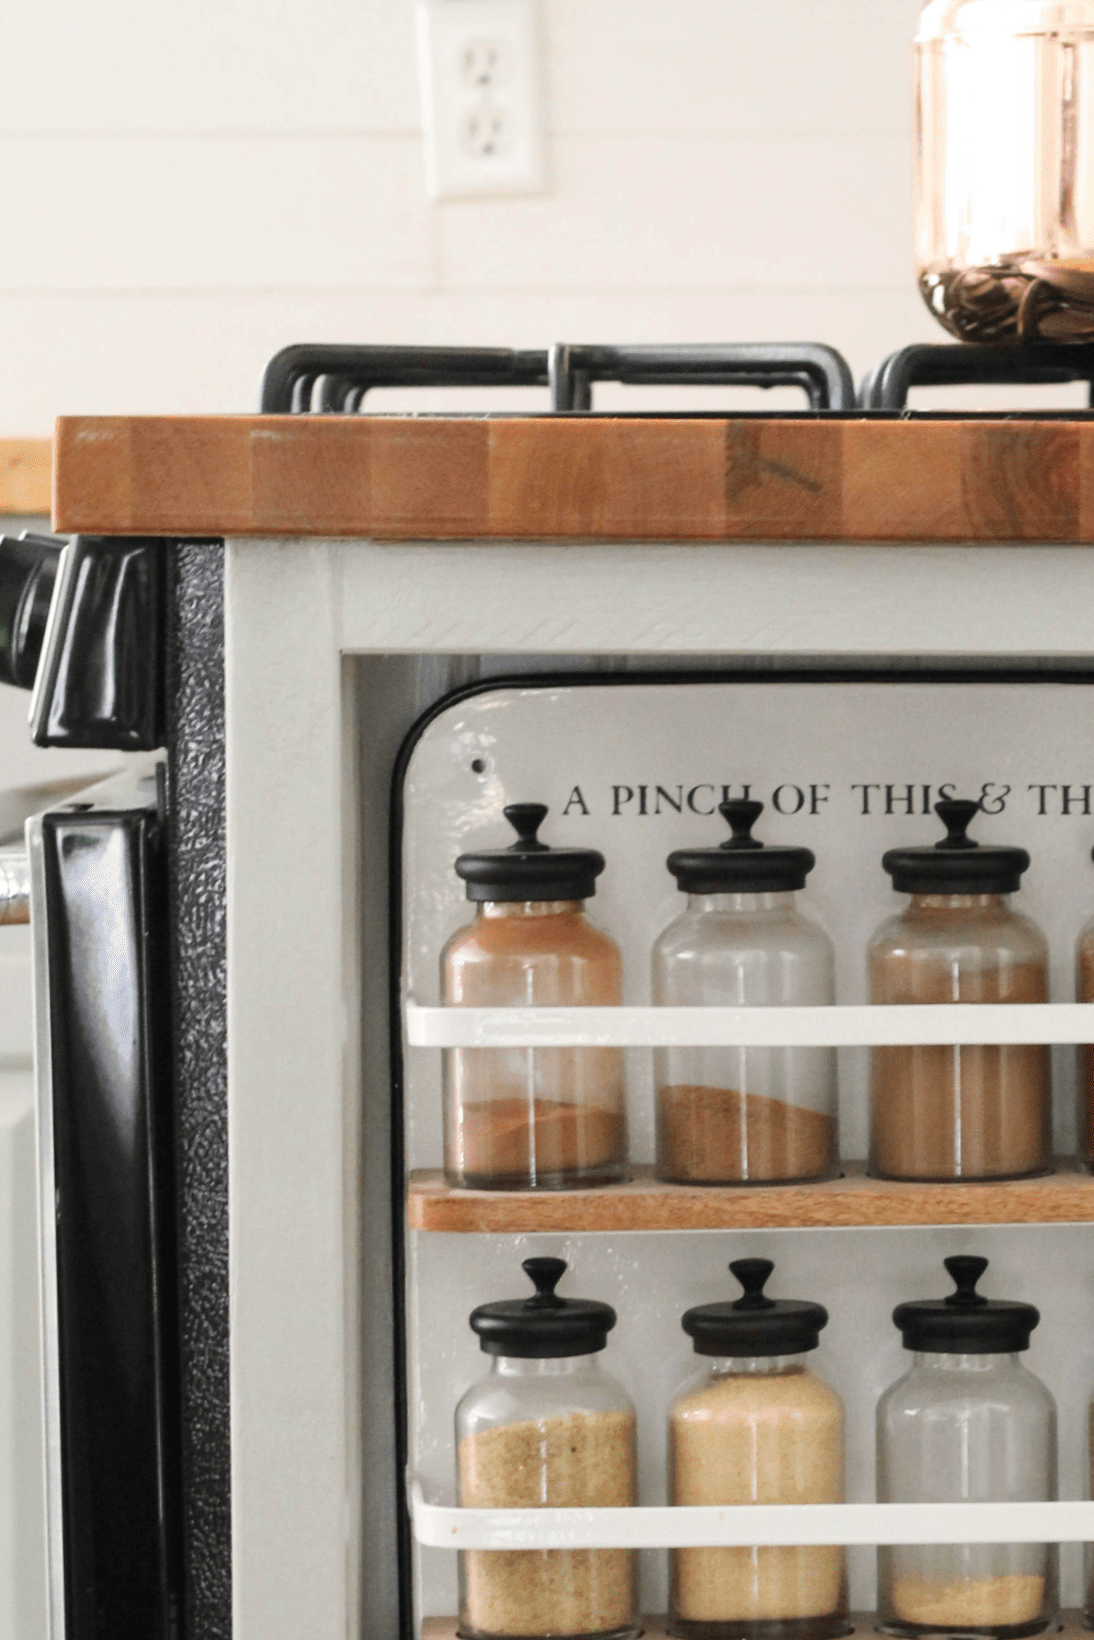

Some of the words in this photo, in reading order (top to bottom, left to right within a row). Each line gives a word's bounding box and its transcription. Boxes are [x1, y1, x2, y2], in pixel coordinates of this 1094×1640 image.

[562, 785, 591, 815] A
[772, 784, 830, 815] OF
[977, 782, 1011, 815] &
